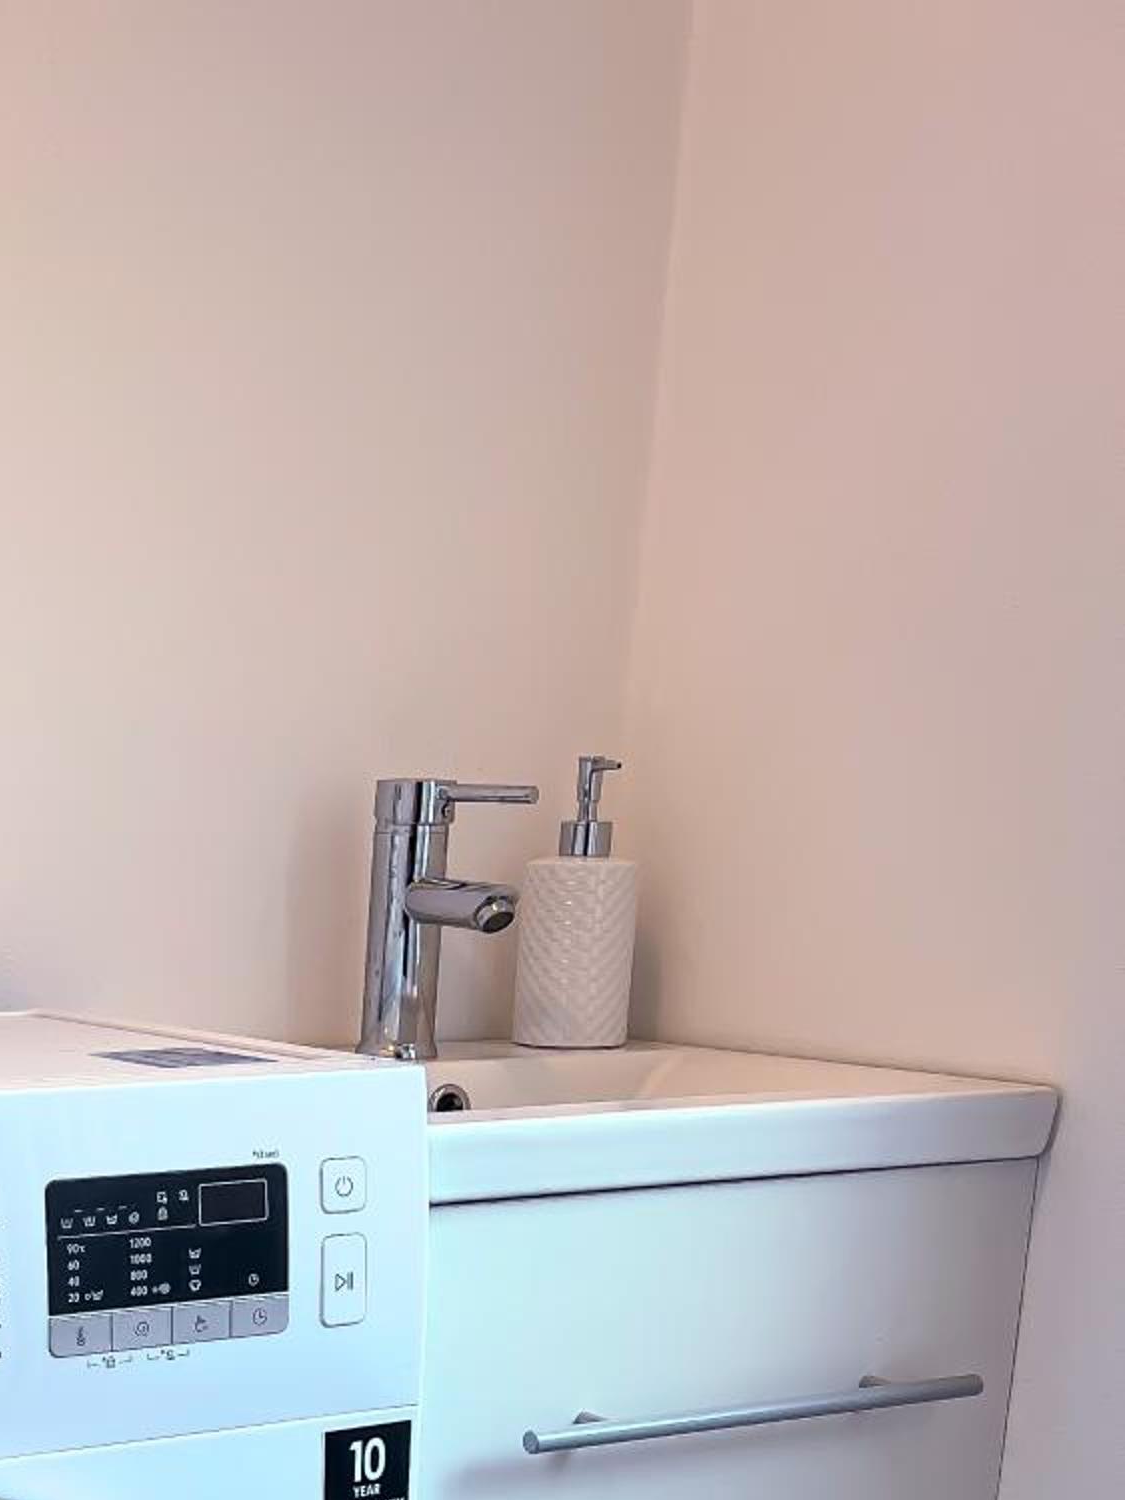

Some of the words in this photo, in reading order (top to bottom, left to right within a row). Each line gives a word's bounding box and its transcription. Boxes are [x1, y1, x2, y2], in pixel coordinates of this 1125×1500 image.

[129, 1237, 152, 1249] 1200
[67, 1259, 80, 1271] 60
[67, 1275, 80, 1287] 40
[67, 1292, 80, 1303] 20
[349, 1437, 386, 1483] 10
[352, 1483, 381, 1498] YEAR
